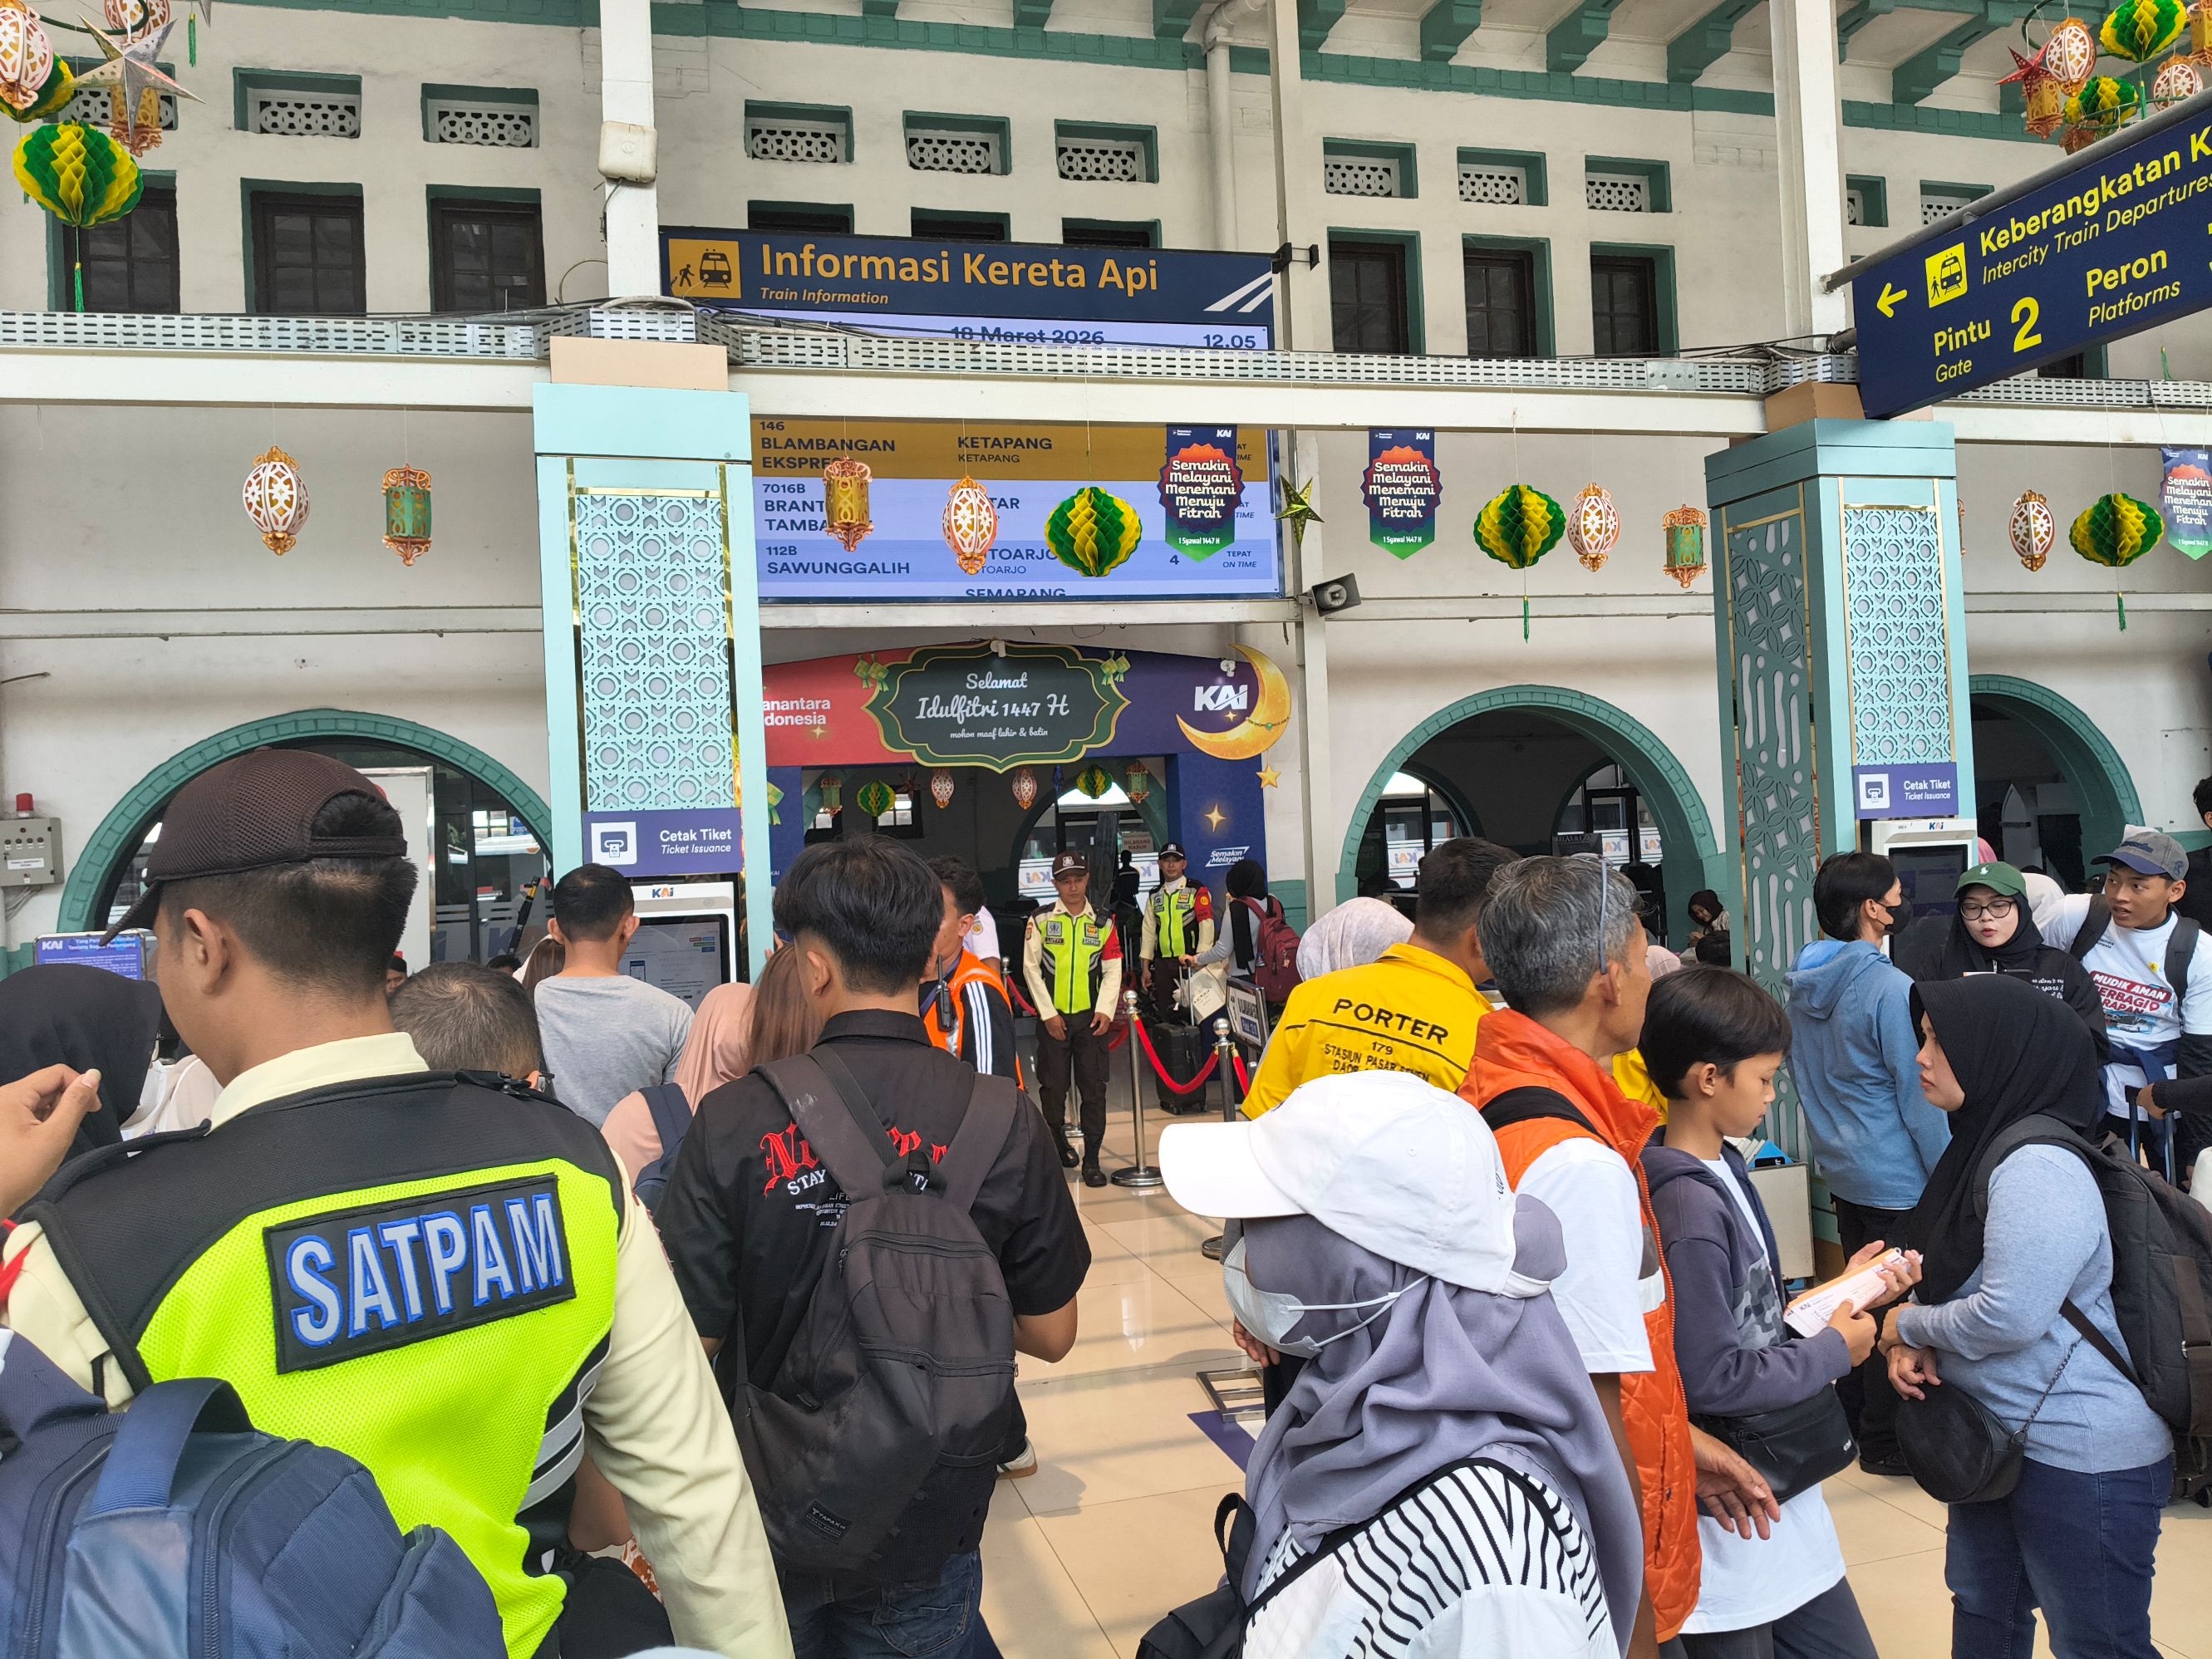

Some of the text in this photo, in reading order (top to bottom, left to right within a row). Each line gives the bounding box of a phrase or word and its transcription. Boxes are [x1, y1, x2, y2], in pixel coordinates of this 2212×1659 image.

[1980, 150, 2180, 257] Keberangkatan
[1983, 242, 2049, 285] Intercity
[2054, 221, 2099, 254] Train
[762, 243, 1157, 297] Informasi Kereta Api
[2087, 249, 2167, 298] Peron
[760, 287, 888, 304] Train Information
[2088, 279, 2180, 328] Platforms
[1934, 296, 2042, 357] Pintu 2
[951, 326, 1104, 345] 18 Maret 2026
[1203, 335, 1256, 348] 12.05
[1935, 359, 1973, 384] Gate
[759, 422, 784, 430] 146
[1217, 429, 1231, 438] KAI
[761, 437, 1052, 451] BLAMBANGAN KETAPANG
[958, 454, 1020, 463] KETAPANG
[1172, 459, 1230, 471] Semakin
[1375, 461, 1429, 472] Semakin
[1170, 472, 1232, 485] Melayani
[1373, 473, 1432, 486] Melayani
[2168, 477, 2210, 487] Semakin
[763, 483, 805, 493] 7016B
[1166, 483, 1236, 495] Menemani
[1369, 484, 1436, 495] Menemani
[1176, 495, 1225, 509] Menuju
[1379, 495, 1426, 508] Menuju
[1179, 508, 1222, 518] Fitrah
[1384, 508, 1423, 518] Fitrah
[2173, 506, 2209, 516] Menuju
[2177, 515, 2207, 526] Fitrah
[766, 546, 797, 555] 112B
[1170, 555, 1179, 565] 4
[768, 562, 910, 574] SAWUNGGALIH
[966, 671, 1028, 690] Selamat
[763, 698, 831, 710] anantara
[1194, 685, 1248, 711] KAI
[915, 694, 1069, 724] Idulfitri 1447 H
[764, 712, 826, 726] donesia
[951, 727, 1048, 739] mohon maaf lahir & batin
[1904, 779, 1951, 790] Cetak Tiket
[660, 828, 732, 842] Cetak Tiket
[661, 844, 731, 855] Ticket Issuance
[42, 940, 63, 950] KAI
[2093, 974, 2167, 1000] MUDIK AMAN
[2096, 986, 2150, 1009] ERBAGI
[1333, 999, 1448, 1046] PORTER
[1372, 1042, 1394, 1055] 179
[1325, 1043, 1362, 1063] STASIUN
[1366, 1055, 1396, 1071] PASAR
[788, 1170, 827, 1195] STAY
[286, 1193, 564, 1348] SATPAM
